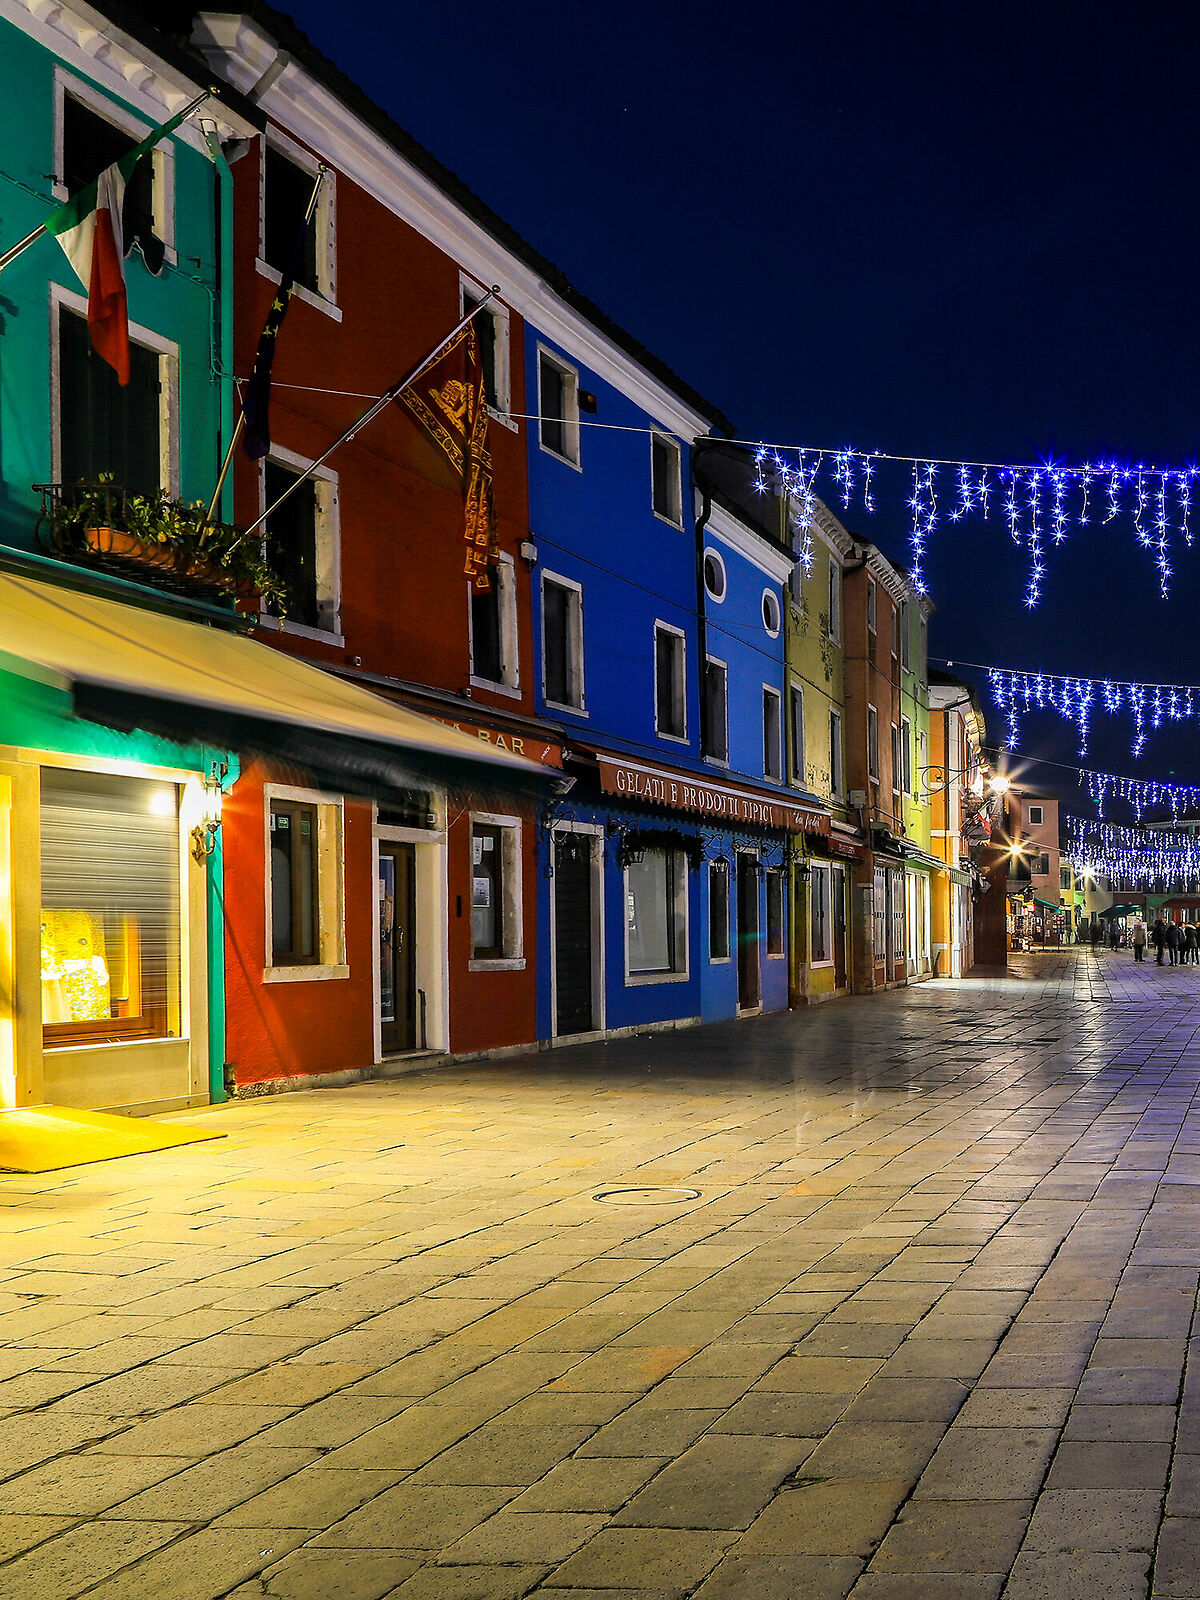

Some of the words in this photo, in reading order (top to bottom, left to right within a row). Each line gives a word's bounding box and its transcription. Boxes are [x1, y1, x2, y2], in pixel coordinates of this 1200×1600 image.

[477, 728, 525, 755] BAR
[616, 769, 665, 800] GELATI
[670, 783, 677, 802] E
[683, 786, 739, 816] PRODOTTI
[742, 800, 773, 823] TIPICI
